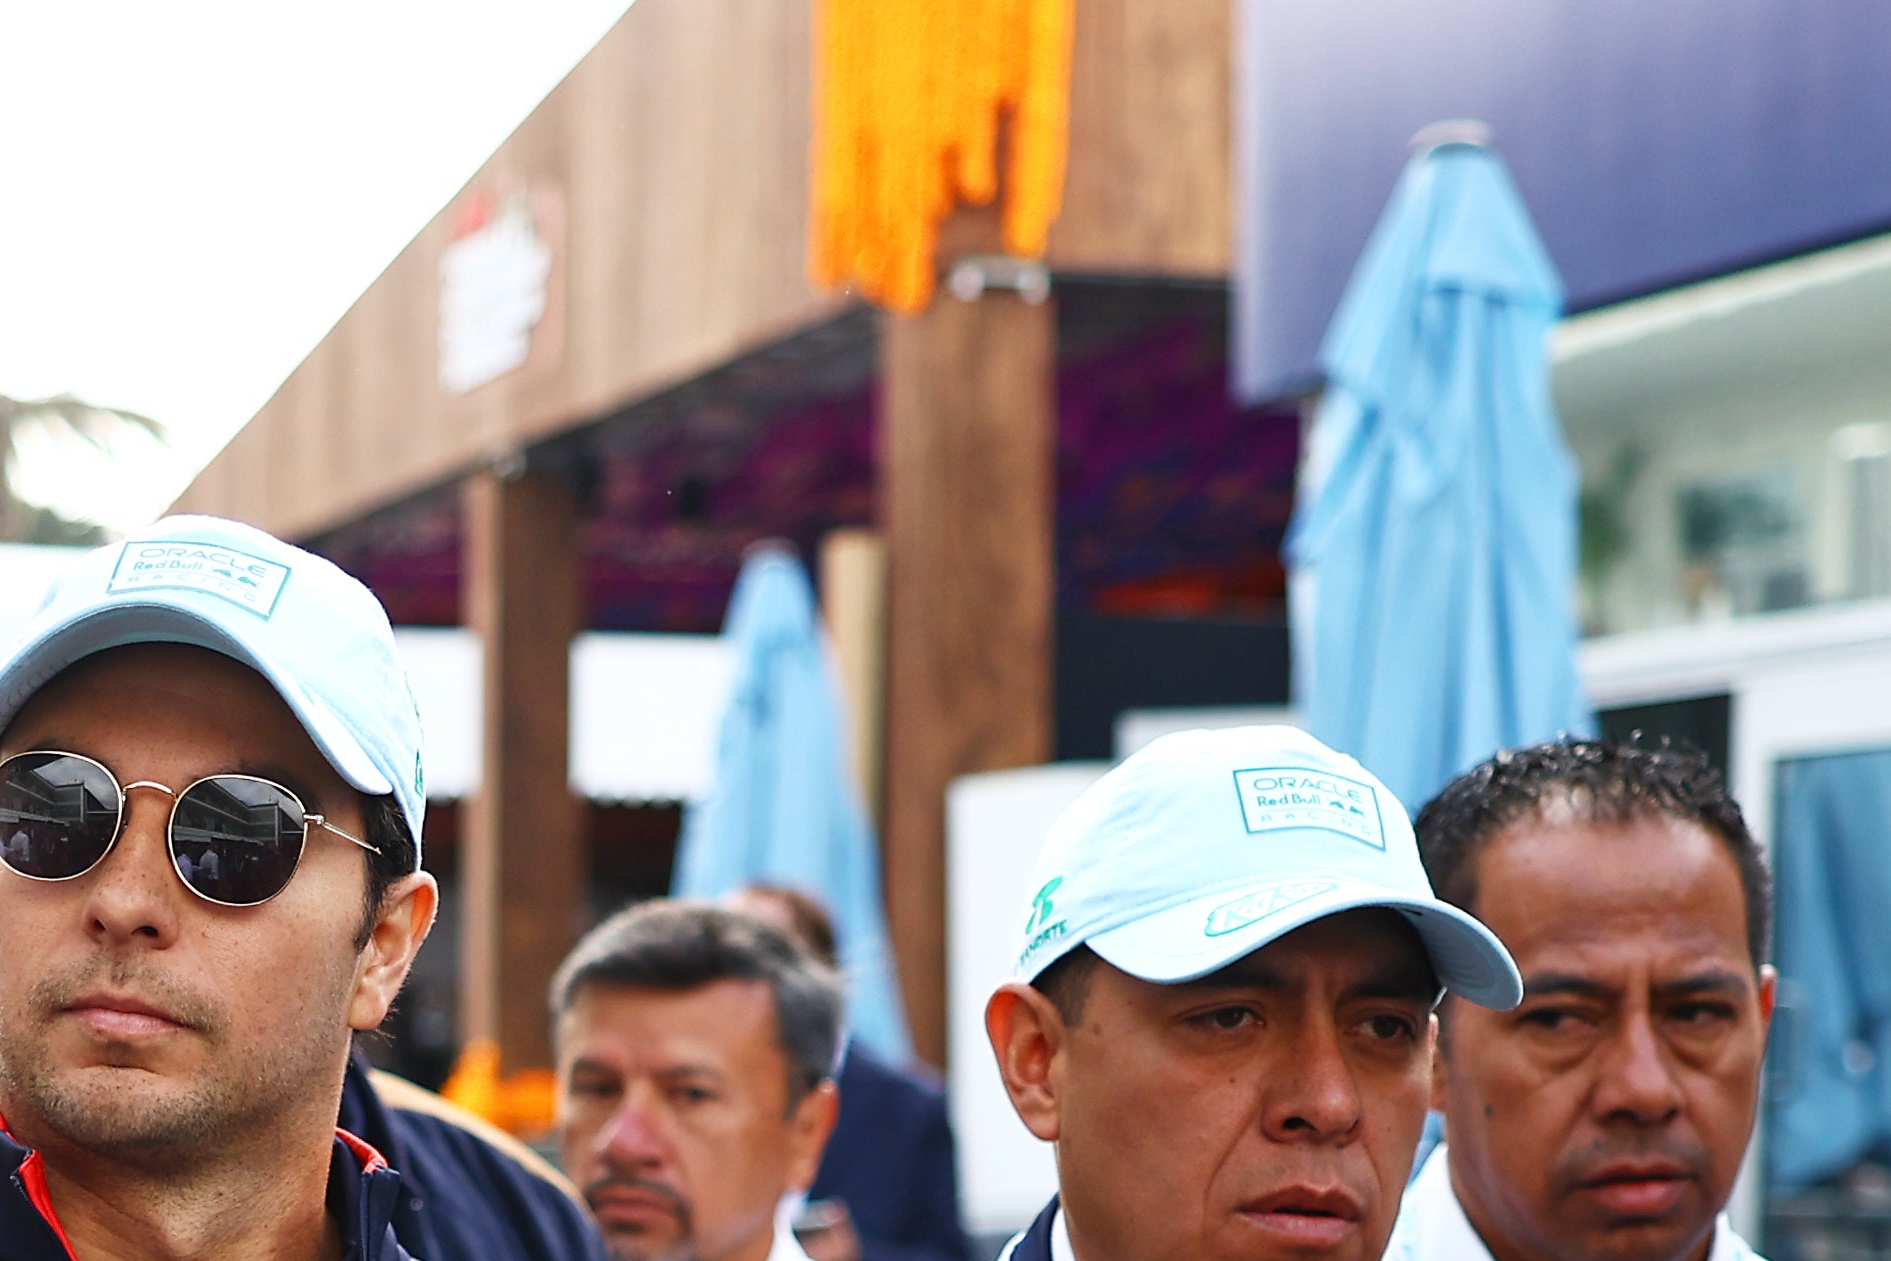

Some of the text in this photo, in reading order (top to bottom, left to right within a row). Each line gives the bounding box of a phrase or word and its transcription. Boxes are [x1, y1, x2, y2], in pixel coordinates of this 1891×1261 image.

[133, 560, 204, 572] Red Bull
[139, 547, 268, 579] ORACLE
[1253, 777, 1363, 804] ORACLE
[1257, 793, 1321, 807] Red Bull
